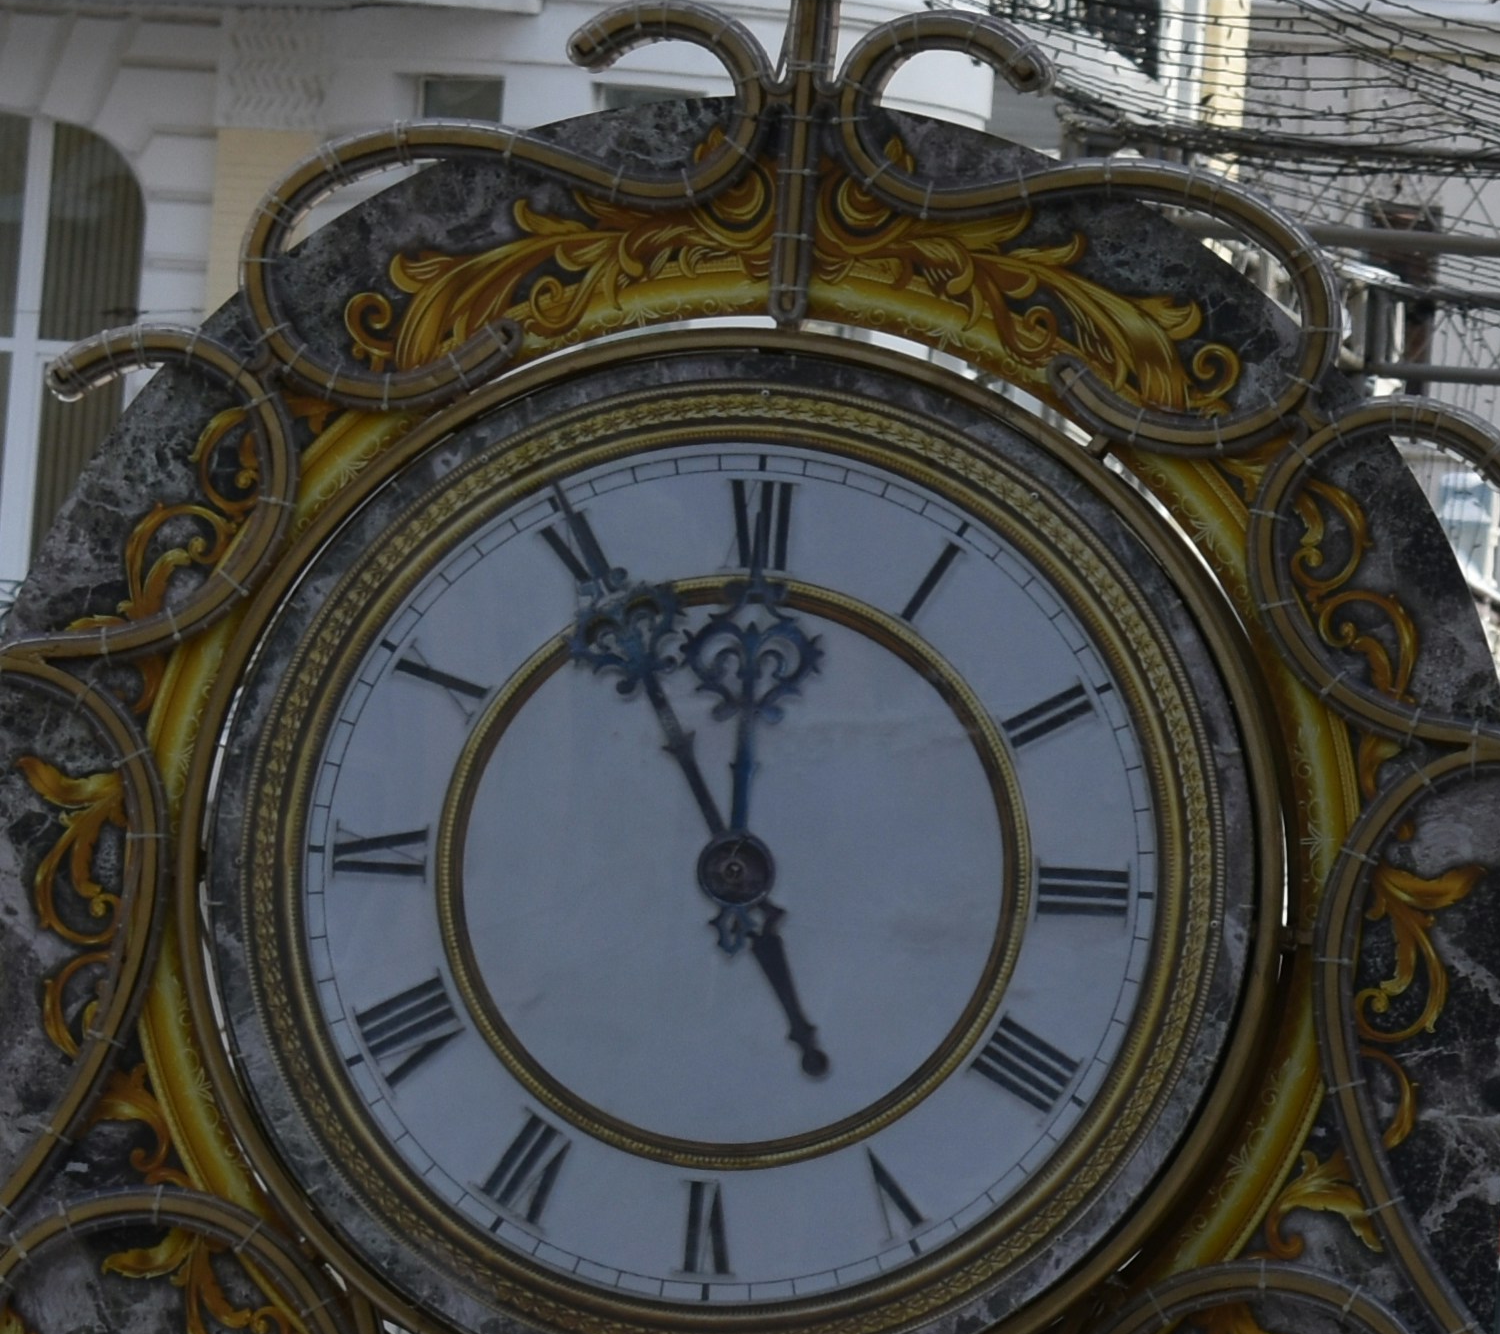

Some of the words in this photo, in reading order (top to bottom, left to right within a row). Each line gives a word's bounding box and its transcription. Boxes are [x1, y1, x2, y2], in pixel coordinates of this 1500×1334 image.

[393, 635, 494, 727] X
[1000, 675, 1098, 752] II
[331, 817, 431, 885] IX
[1034, 857, 1131, 929] III
[350, 967, 466, 1097] VIII
[466, 1105, 575, 1237] VII
[866, 1145, 932, 1243] V
[669, 1177, 739, 1279] VI
